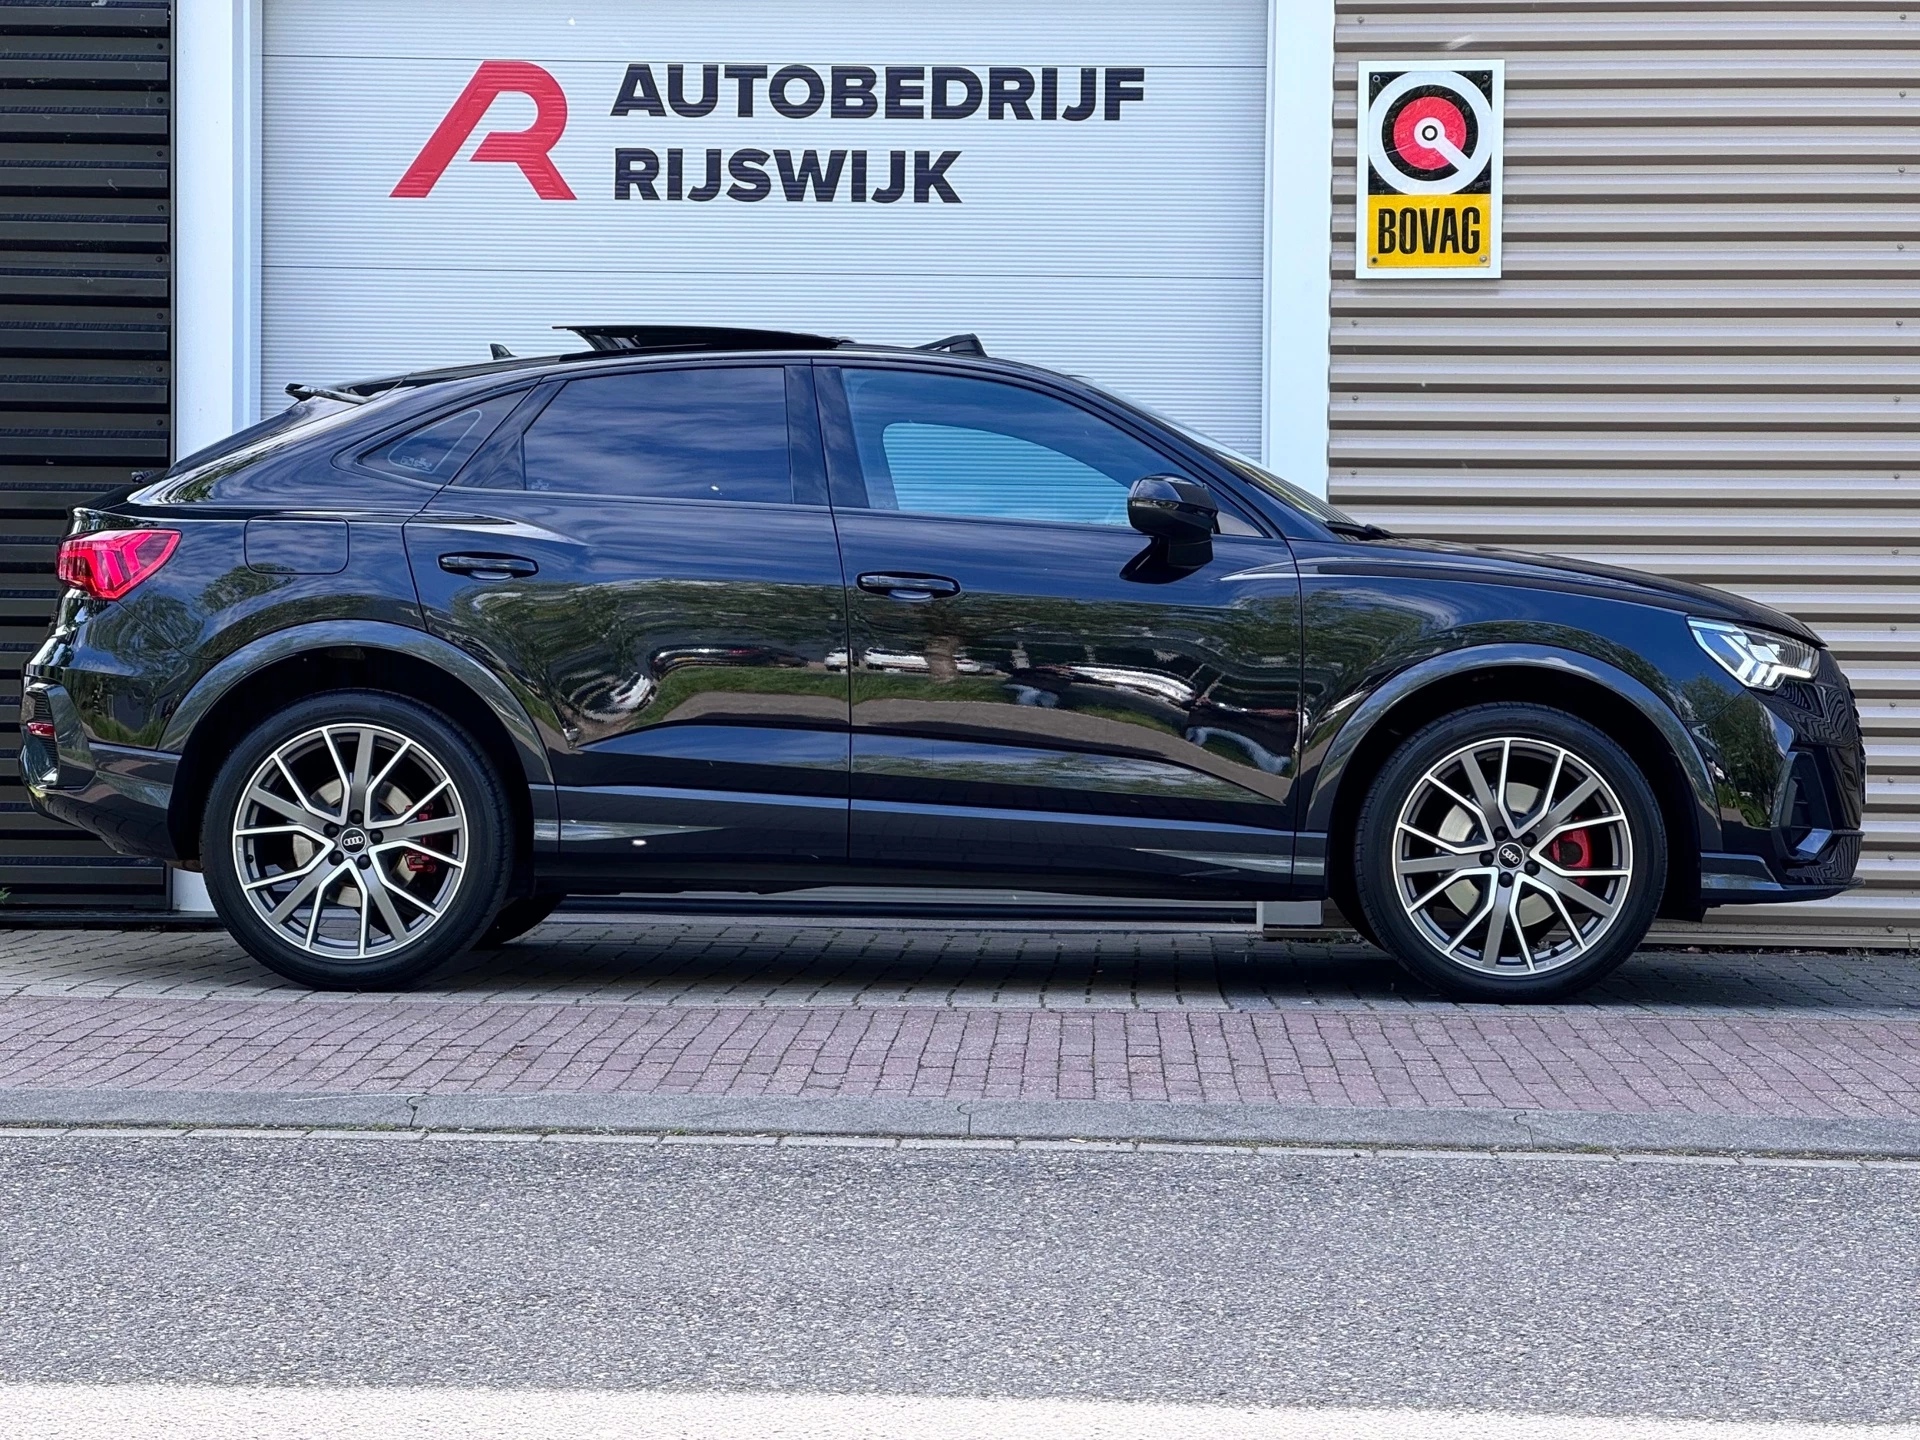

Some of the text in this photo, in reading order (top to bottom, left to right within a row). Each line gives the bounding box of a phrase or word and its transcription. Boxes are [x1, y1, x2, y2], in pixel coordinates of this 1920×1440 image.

[610, 64, 1145, 121] AUTOBEDRIJF
[614, 147, 962, 204] RIJSWIJK
[1378, 207, 1480, 254] BOVAG
